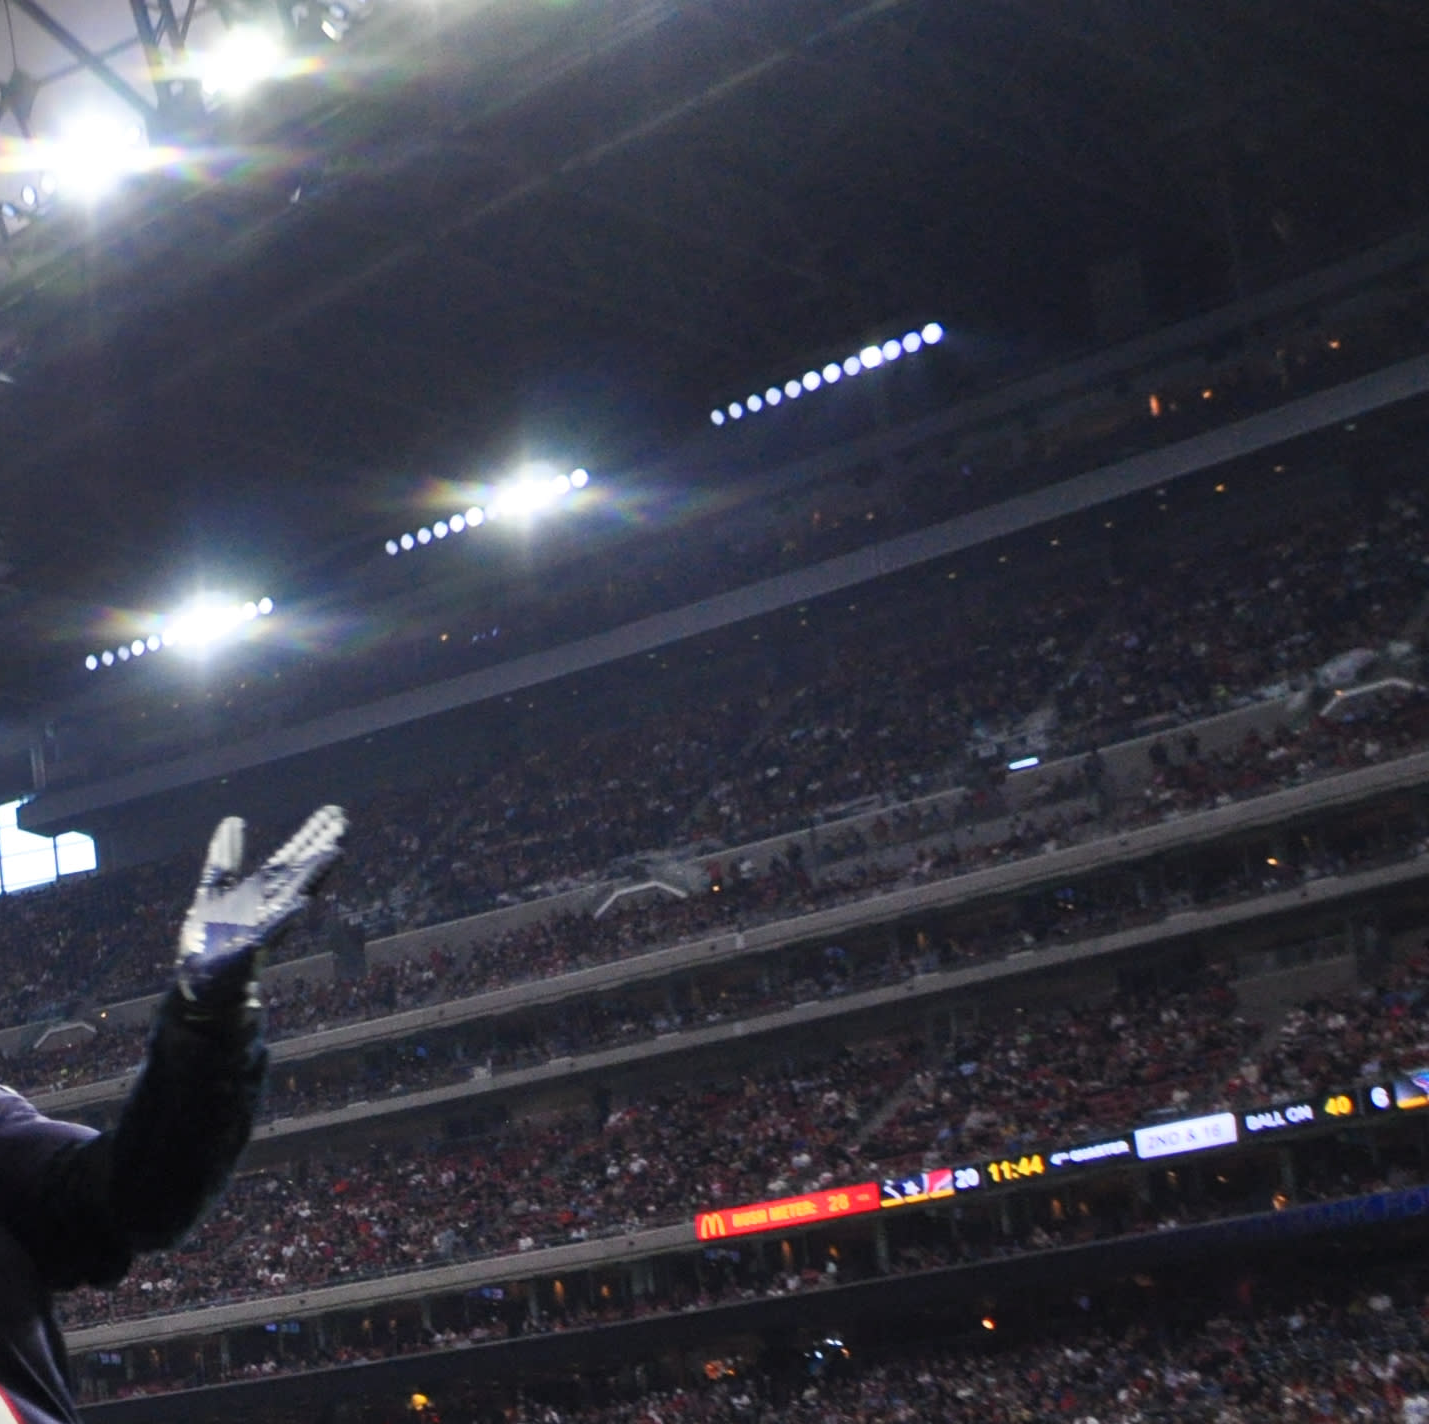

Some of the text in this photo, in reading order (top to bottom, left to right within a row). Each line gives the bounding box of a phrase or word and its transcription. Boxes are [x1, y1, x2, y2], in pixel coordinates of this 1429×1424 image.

[1245, 1111, 1287, 1132] BALL
[1324, 1095, 1354, 1117] 40
[954, 1154, 1045, 1190] 20 11:44
